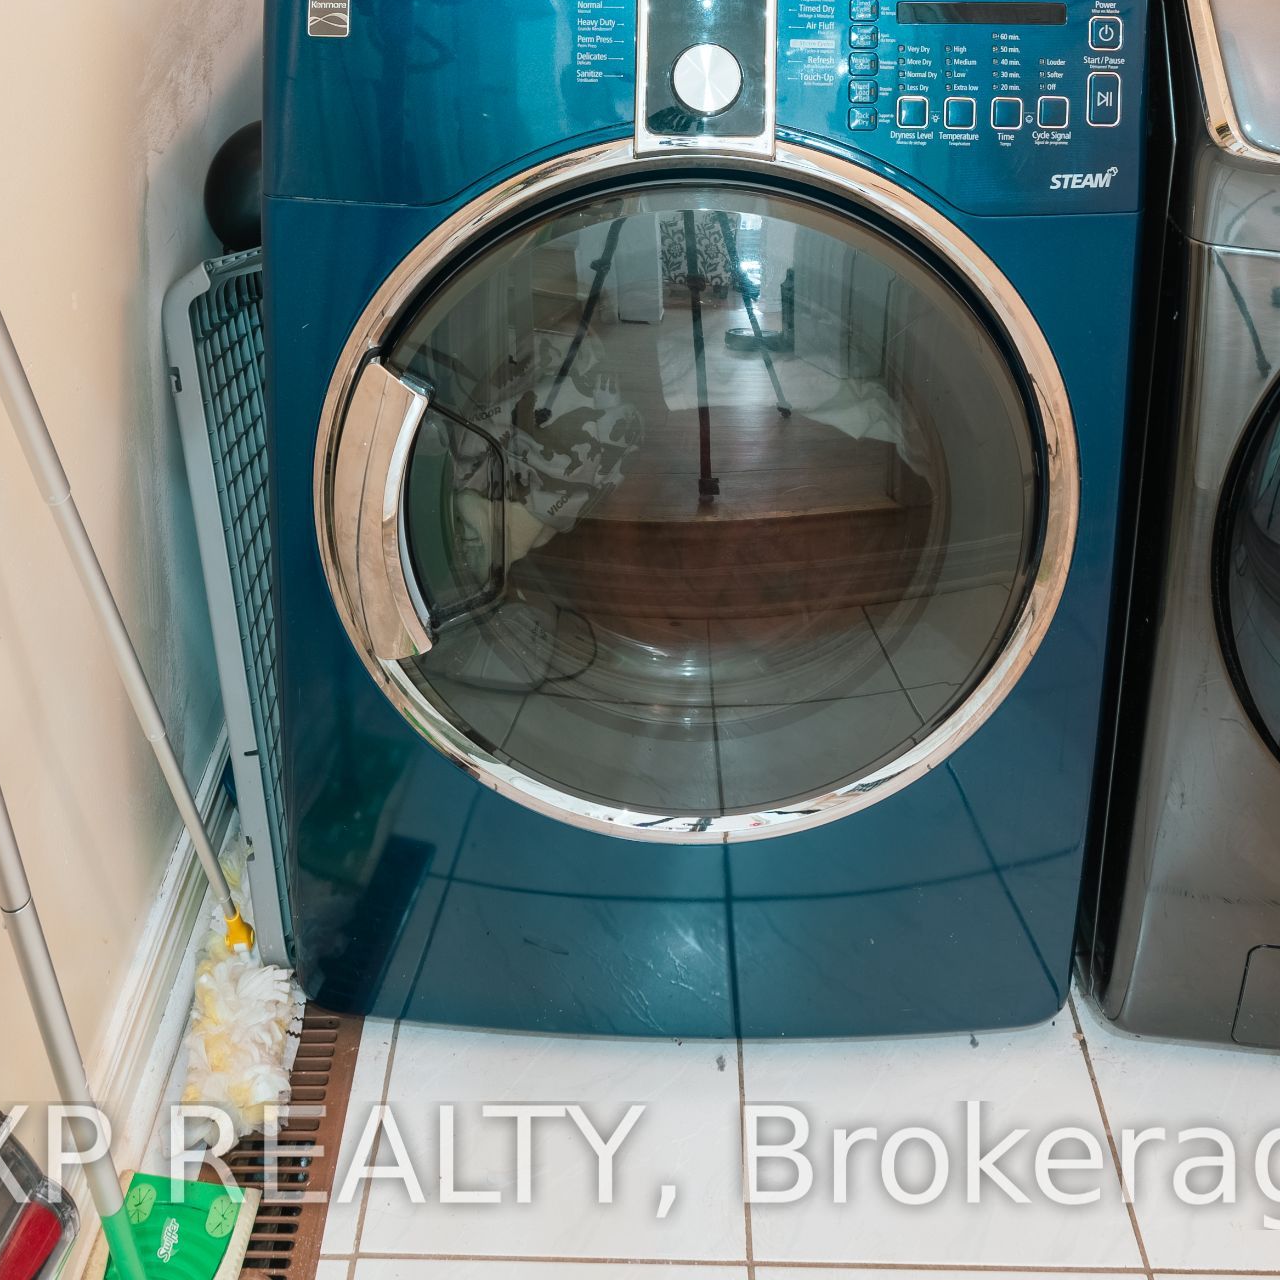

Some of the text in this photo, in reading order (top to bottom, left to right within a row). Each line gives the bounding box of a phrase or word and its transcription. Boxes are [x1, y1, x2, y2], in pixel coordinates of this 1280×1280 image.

[311, 0, 347, 9] Kenmore
[577, 0, 603, 9] Normal
[799, 4, 835, 14] Timed Dry
[1095, 1, 1117, 9] Power
[577, 18, 616, 28] Heavy Duty
[806, 22, 835, 30] Air Fluff
[577, 35, 613, 44] Perm Press
[908, 46, 920, 54] Very
[954, 46, 967, 54] High
[576, 52, 608, 61] Delicates
[808, 56, 835, 64] Refresh
[576, 69, 603, 78] Sanitize
[800, 73, 835, 82] Touch-Up
[928, 71, 937, 79] Dry
[919, 84, 929, 92] Dry
[890, 131, 934, 140] Dryness Level
[939, 132, 979, 141] Temperature
[997, 132, 1015, 141] Time
[1032, 131, 1071, 141] Cycle Signal
[1049, 173, 1112, 189] STEAM
[157, 1218, 180, 1263] Swiffer
